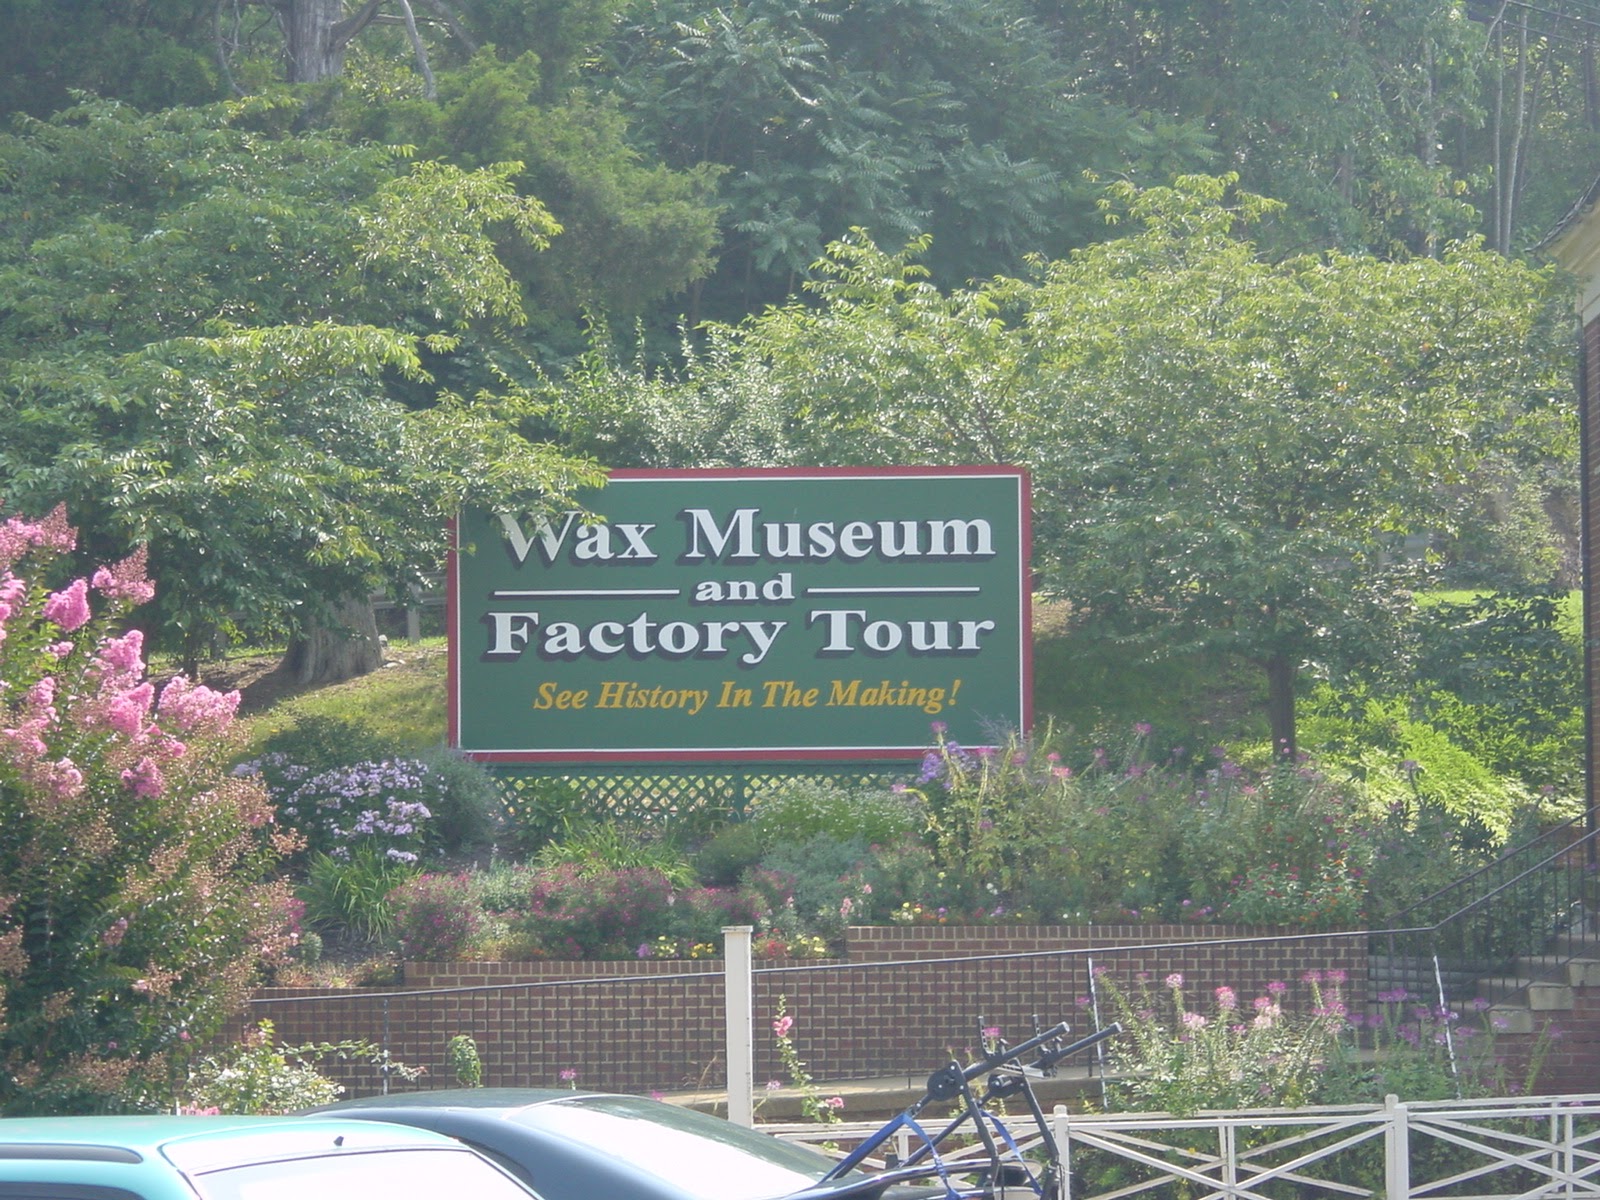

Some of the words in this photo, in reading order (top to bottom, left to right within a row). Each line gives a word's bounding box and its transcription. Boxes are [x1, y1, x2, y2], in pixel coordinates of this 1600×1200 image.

[498, 510, 658, 562] Wax
[684, 508, 996, 559] Museum
[695, 573, 795, 601] and
[487, 611, 787, 664] Factory
[811, 609, 996, 652] Tour
[534, 681, 587, 710] See
[597, 681, 708, 715] History
[716, 681, 752, 708] In
[762, 680, 818, 708] The
[827, 679, 962, 714] Making!
